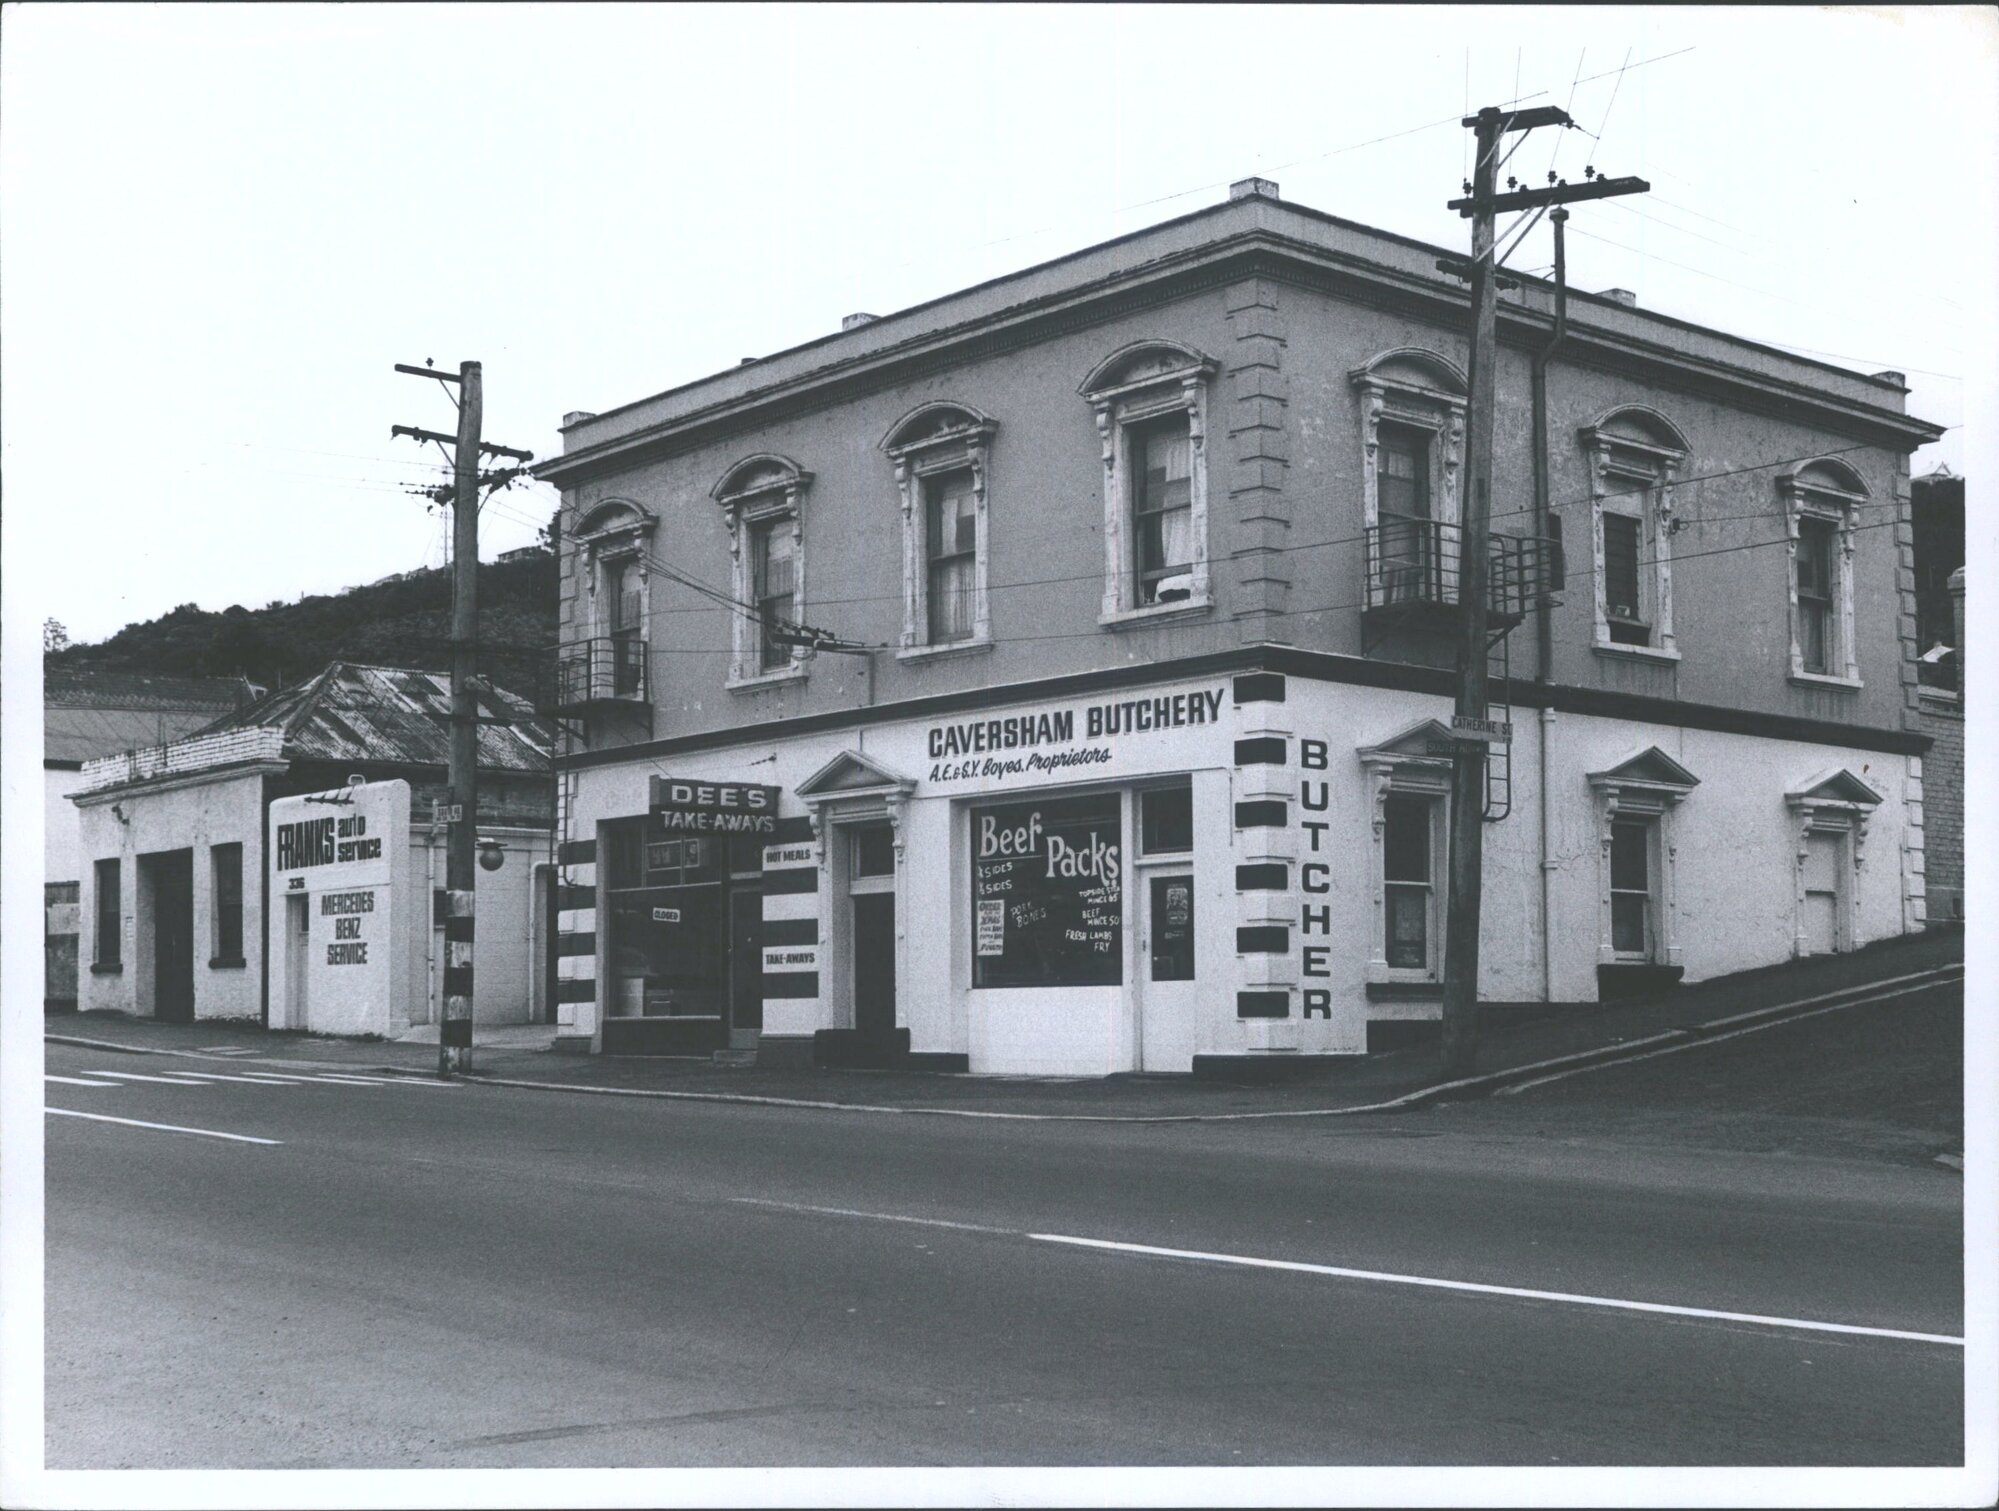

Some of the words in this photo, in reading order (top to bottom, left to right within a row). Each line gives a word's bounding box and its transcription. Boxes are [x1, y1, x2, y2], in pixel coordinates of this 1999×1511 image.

[929, 710, 1073, 759] CAVERSHAM
[1087, 688, 1225, 739] BUTCHERY
[1452, 717, 1497, 734] CATHERINE
[1025, 747, 1113, 776] Proprietors
[338, 813, 366, 838] auto
[661, 811, 775, 833] TAKE-AWAYS
[277, 817, 335, 872] FRANKS
[979, 812, 1043, 857] Beef
[338, 838, 382, 862] service
[766, 850, 781, 863] HOT
[783, 848, 811, 862] MEALS
[1045, 832, 1120, 887] Packs
[985, 879, 1013, 894] SIDES
[1301, 738, 1332, 1020] BUTCHER
[321, 890, 375, 916] MERCEDES
[1082, 907, 1100, 919] BEEF
[336, 917, 361, 940] BENZ
[1088, 916, 1108, 926] MINCE
[1065, 929, 1087, 941] FRESH
[327, 942, 368, 966] SERVICE
[766, 953, 816, 965] TAKE-AWAYS
